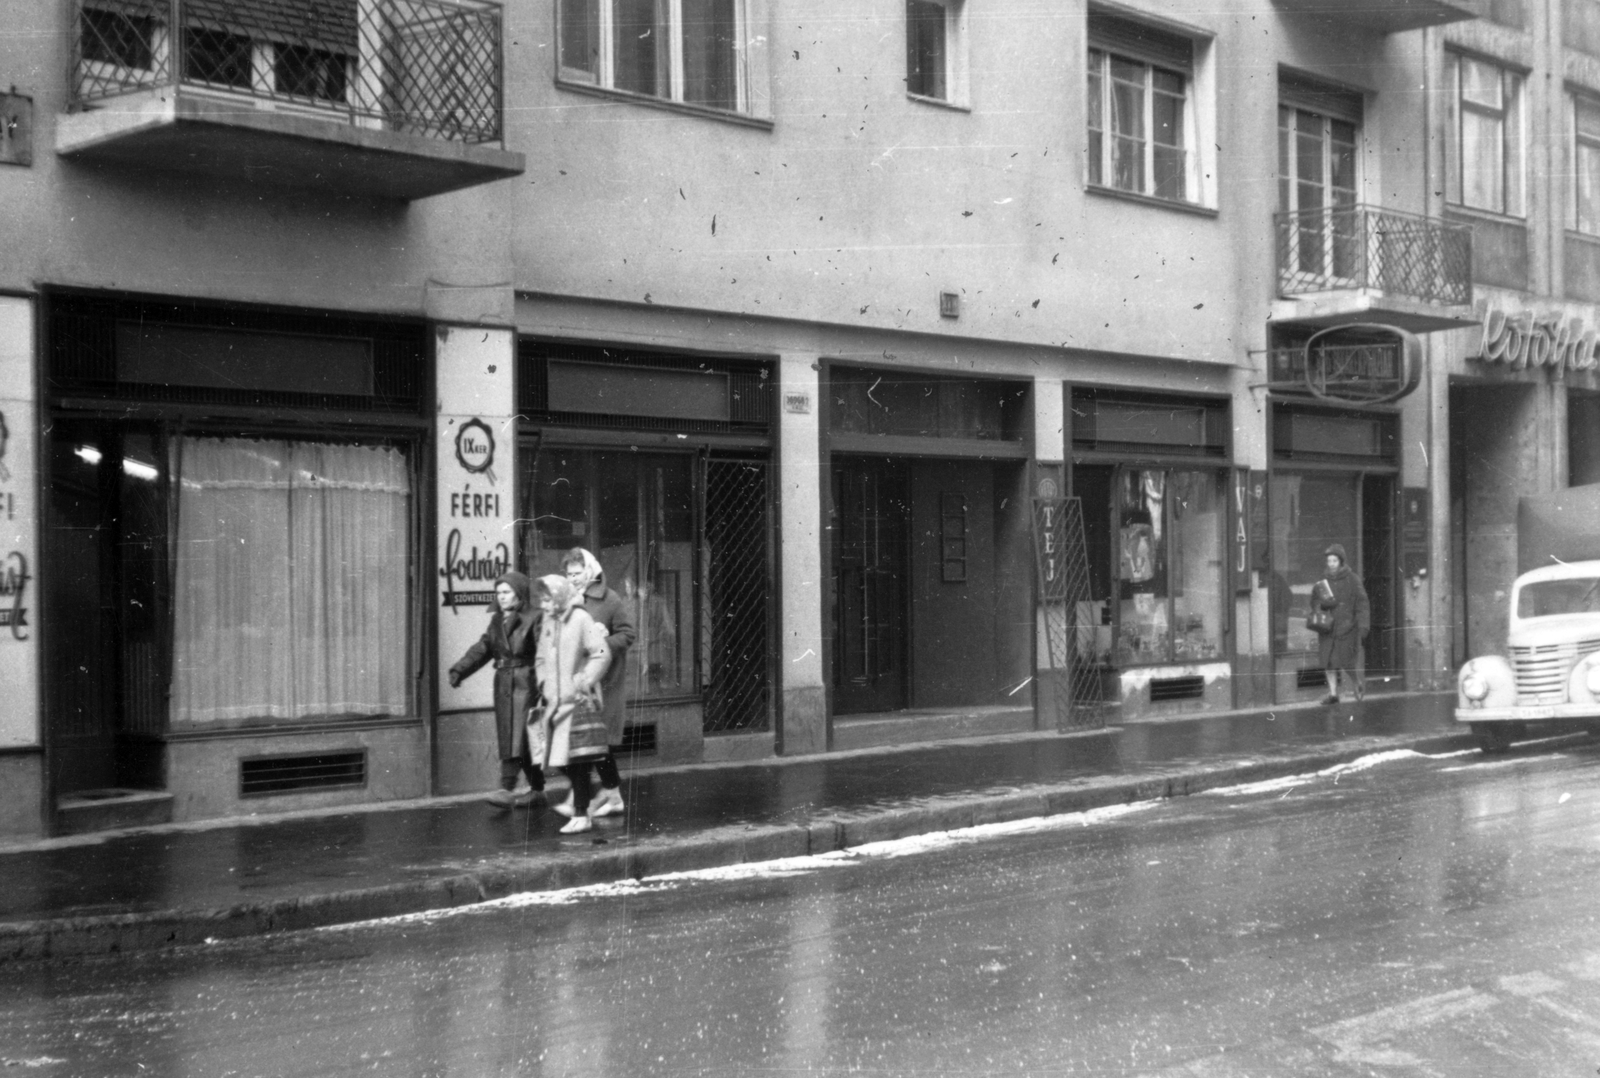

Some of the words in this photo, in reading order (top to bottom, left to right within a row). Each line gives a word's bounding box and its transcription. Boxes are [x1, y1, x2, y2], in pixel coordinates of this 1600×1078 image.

[451, 483, 499, 517] FÉRFI
[1235, 486, 1247, 572] VAJ
[1043, 506, 1055, 581] TEJ
